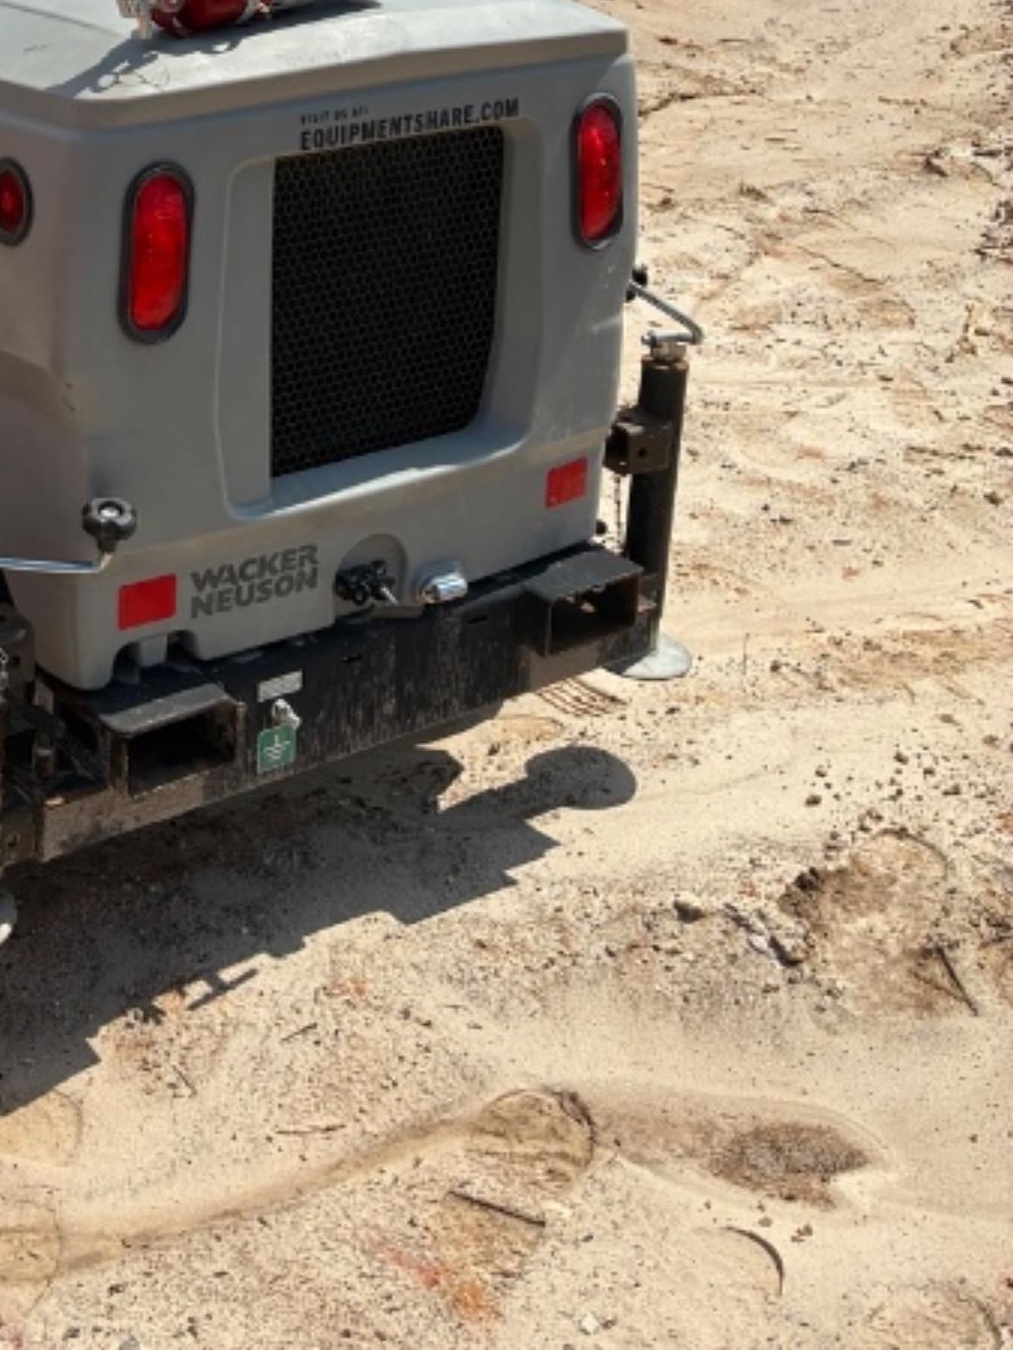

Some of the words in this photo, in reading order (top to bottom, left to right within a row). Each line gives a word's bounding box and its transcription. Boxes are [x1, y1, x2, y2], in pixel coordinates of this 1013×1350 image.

[300, 97, 520, 151] EQUIPMENTSHARE.COM
[190, 545, 319, 590] WACKER
[190, 566, 319, 619] NEUSON
